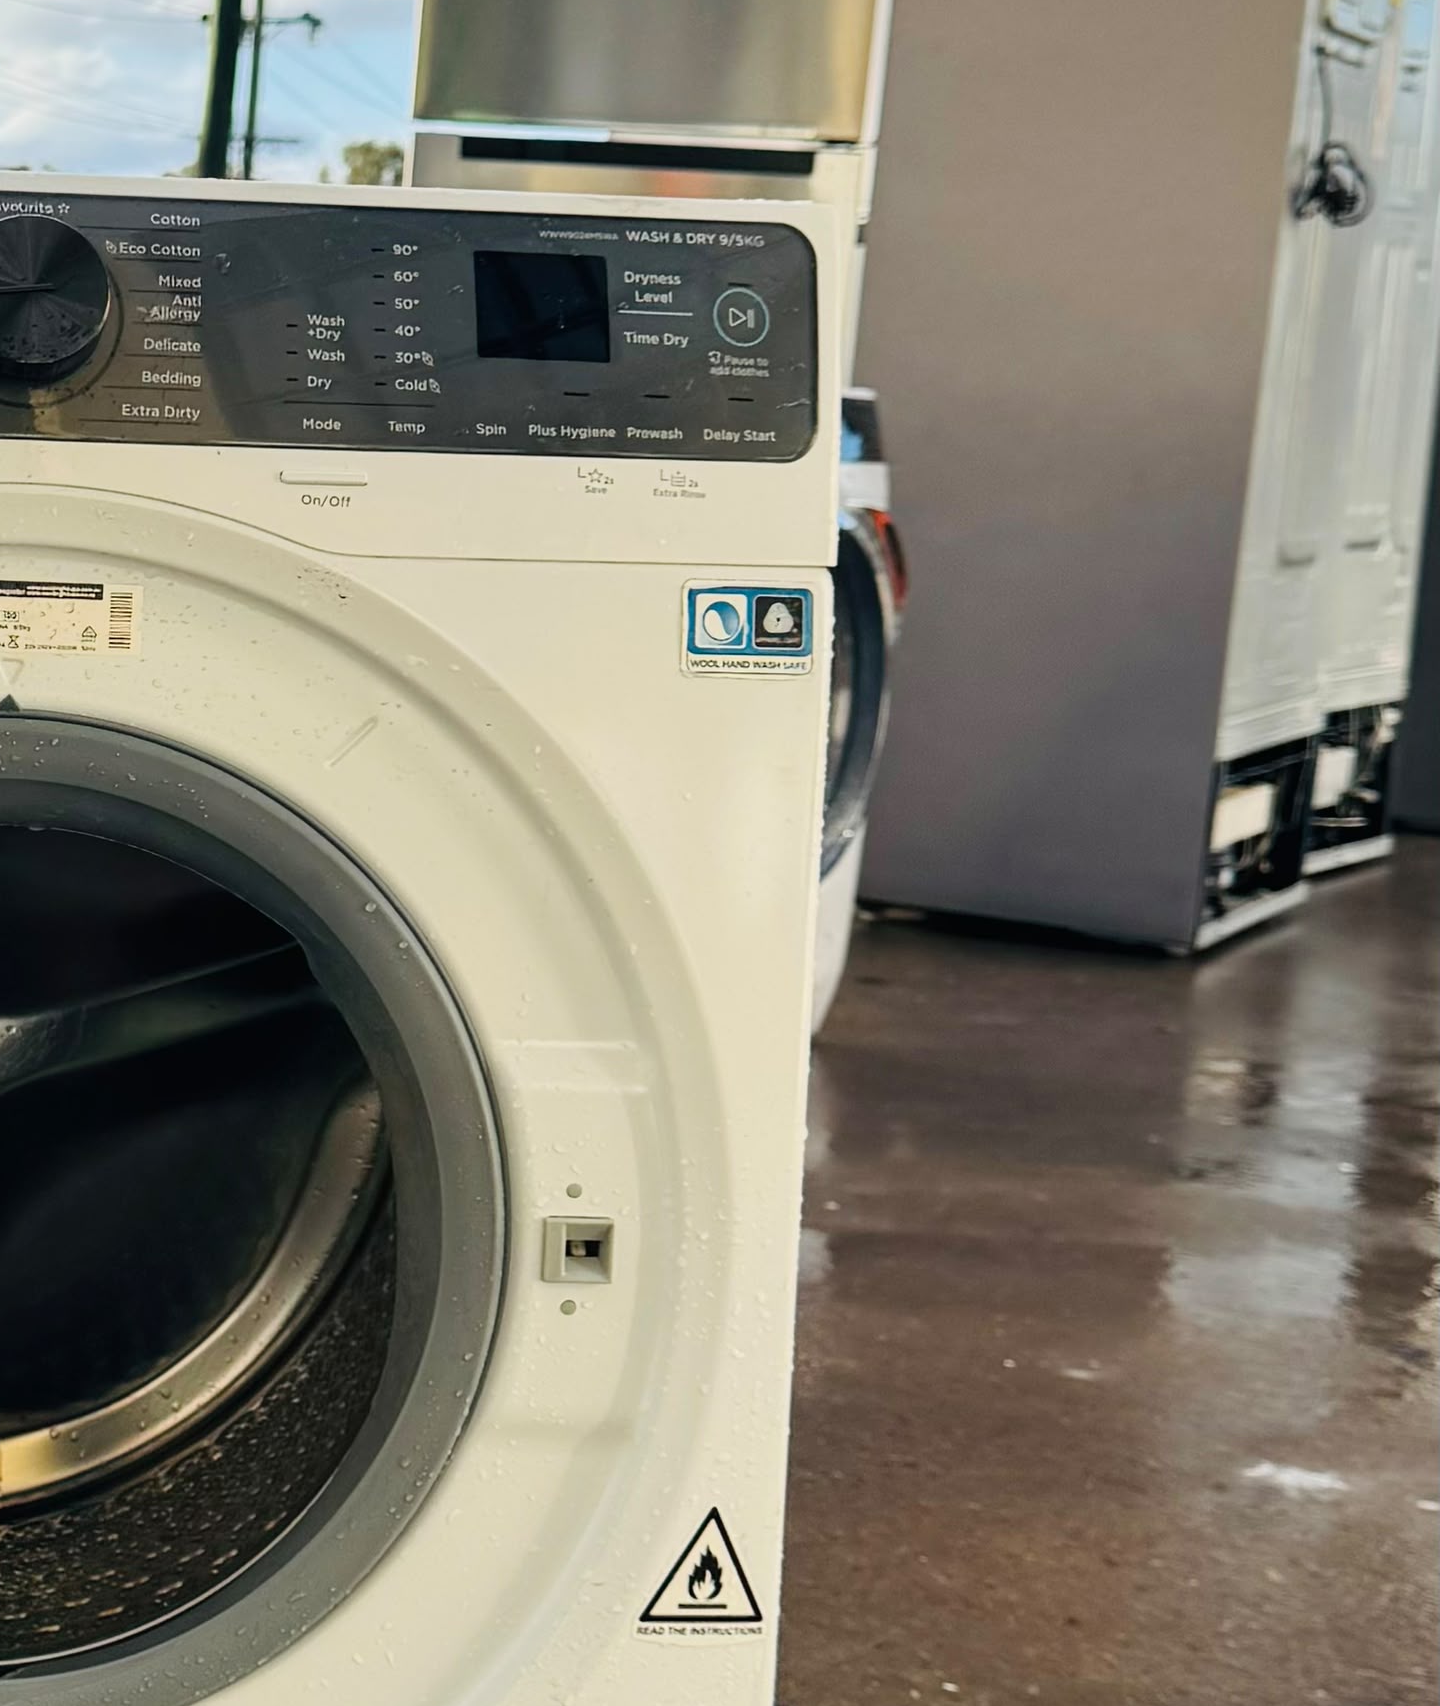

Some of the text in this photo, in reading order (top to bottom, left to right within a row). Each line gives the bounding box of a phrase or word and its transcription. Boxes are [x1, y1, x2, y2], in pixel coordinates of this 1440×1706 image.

[150, 213, 201, 227] Cotton
[626, 230, 670, 243] WASH
[673, 231, 684, 244] &
[686, 233, 715, 245] DRY
[719, 234, 765, 247] 9/5KG
[119, 242, 201, 257] Eco Cotton
[392, 244, 418, 256] 90°
[159, 275, 202, 288] Mixed
[393, 271, 420, 283] 60°
[624, 271, 682, 286] Dryness
[172, 295, 202, 307] Anti
[635, 290, 673, 303] Level
[394, 298, 420, 310] 50°
[150, 306, 201, 322] Allergy
[307, 314, 346, 327] Wash
[307, 327, 342, 342] +Dry
[394, 325, 421, 337] 40°
[144, 338, 201, 352] Delicate
[624, 331, 690, 348] Time Dry
[307, 348, 346, 362] Wash
[142, 370, 201, 387] Bedding
[307, 376, 332, 390] Dry
[395, 378, 428, 392] Cold
[122, 404, 200, 421] Extra Dirty
[303, 418, 342, 431] Mode
[388, 421, 426, 435] Temp
[476, 423, 507, 436] Spin
[528, 424, 617, 440] Plus Hygiene
[703, 428, 776, 444] Delay Start
[301, 494, 351, 508] On/Off
[690, 659, 719, 668] WOOL
[722, 660, 750, 669] HAND
[753, 660, 780, 669] WASH
